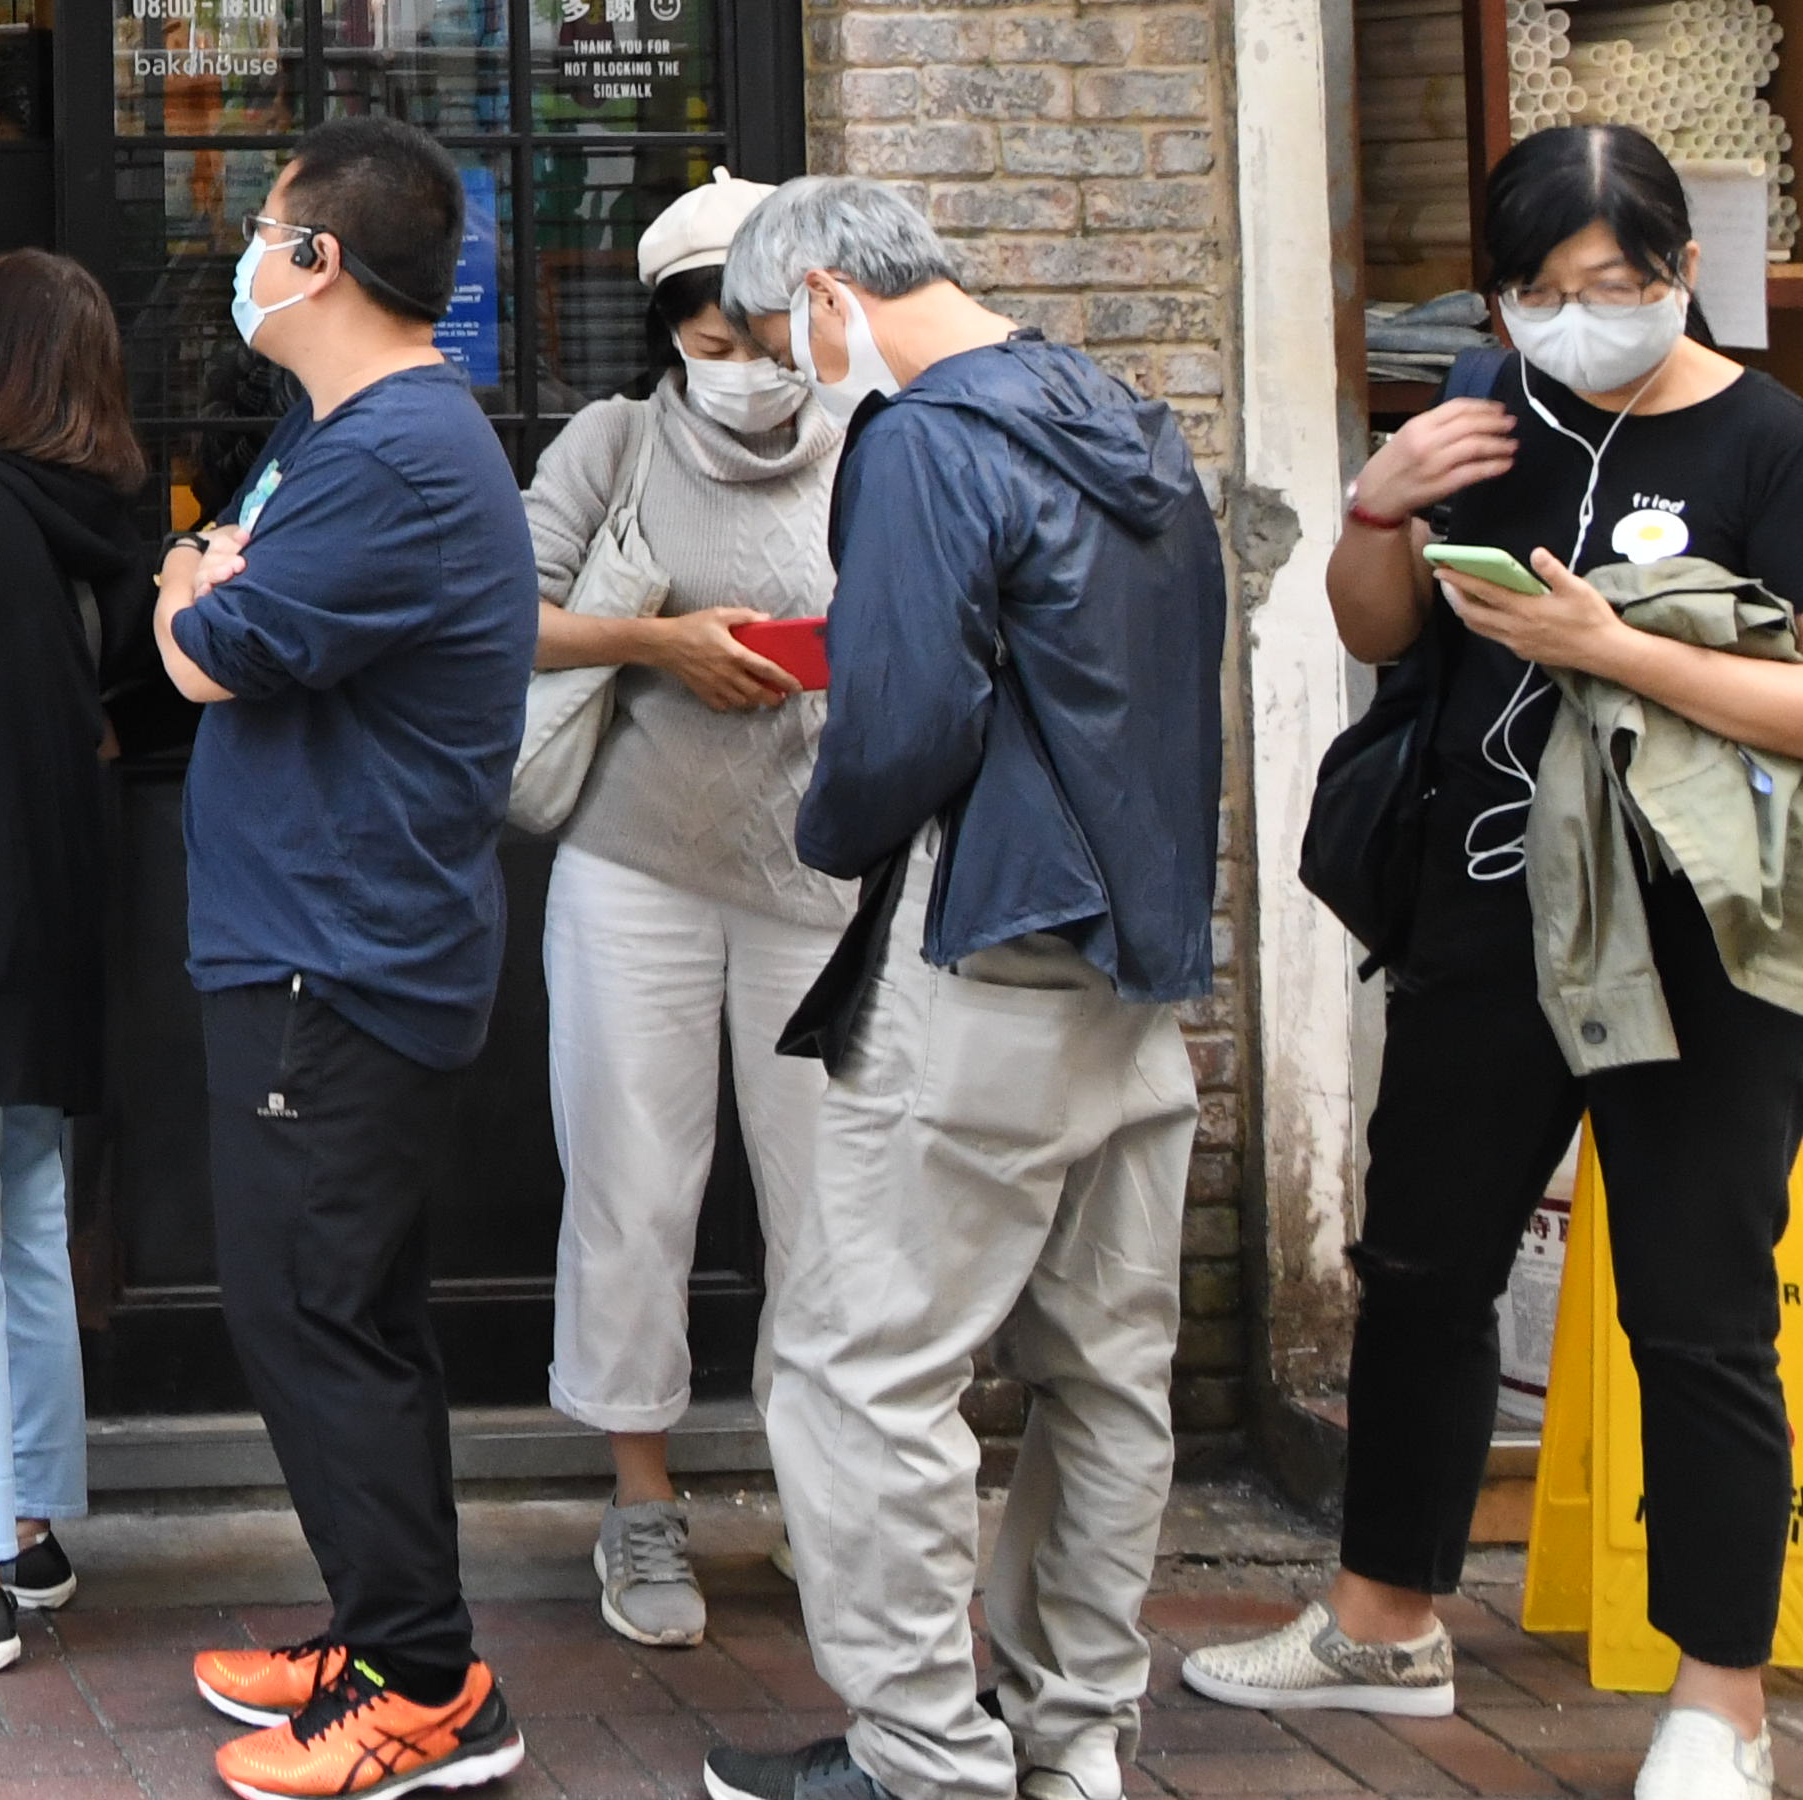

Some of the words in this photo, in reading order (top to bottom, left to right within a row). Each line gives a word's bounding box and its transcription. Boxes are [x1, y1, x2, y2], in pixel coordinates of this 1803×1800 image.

[573, 39, 613, 54] THANK
[620, 39, 642, 54] YOU
[648, 39, 670, 54] FOR
[135, 51, 277, 76] bakehouse
[564, 61, 587, 76] NOT
[593, 61, 652, 76] BLOCKING
[658, 61, 680, 76] THE
[593, 84, 653, 98] SIDEWALK
[1633, 492, 1685, 514] fried
